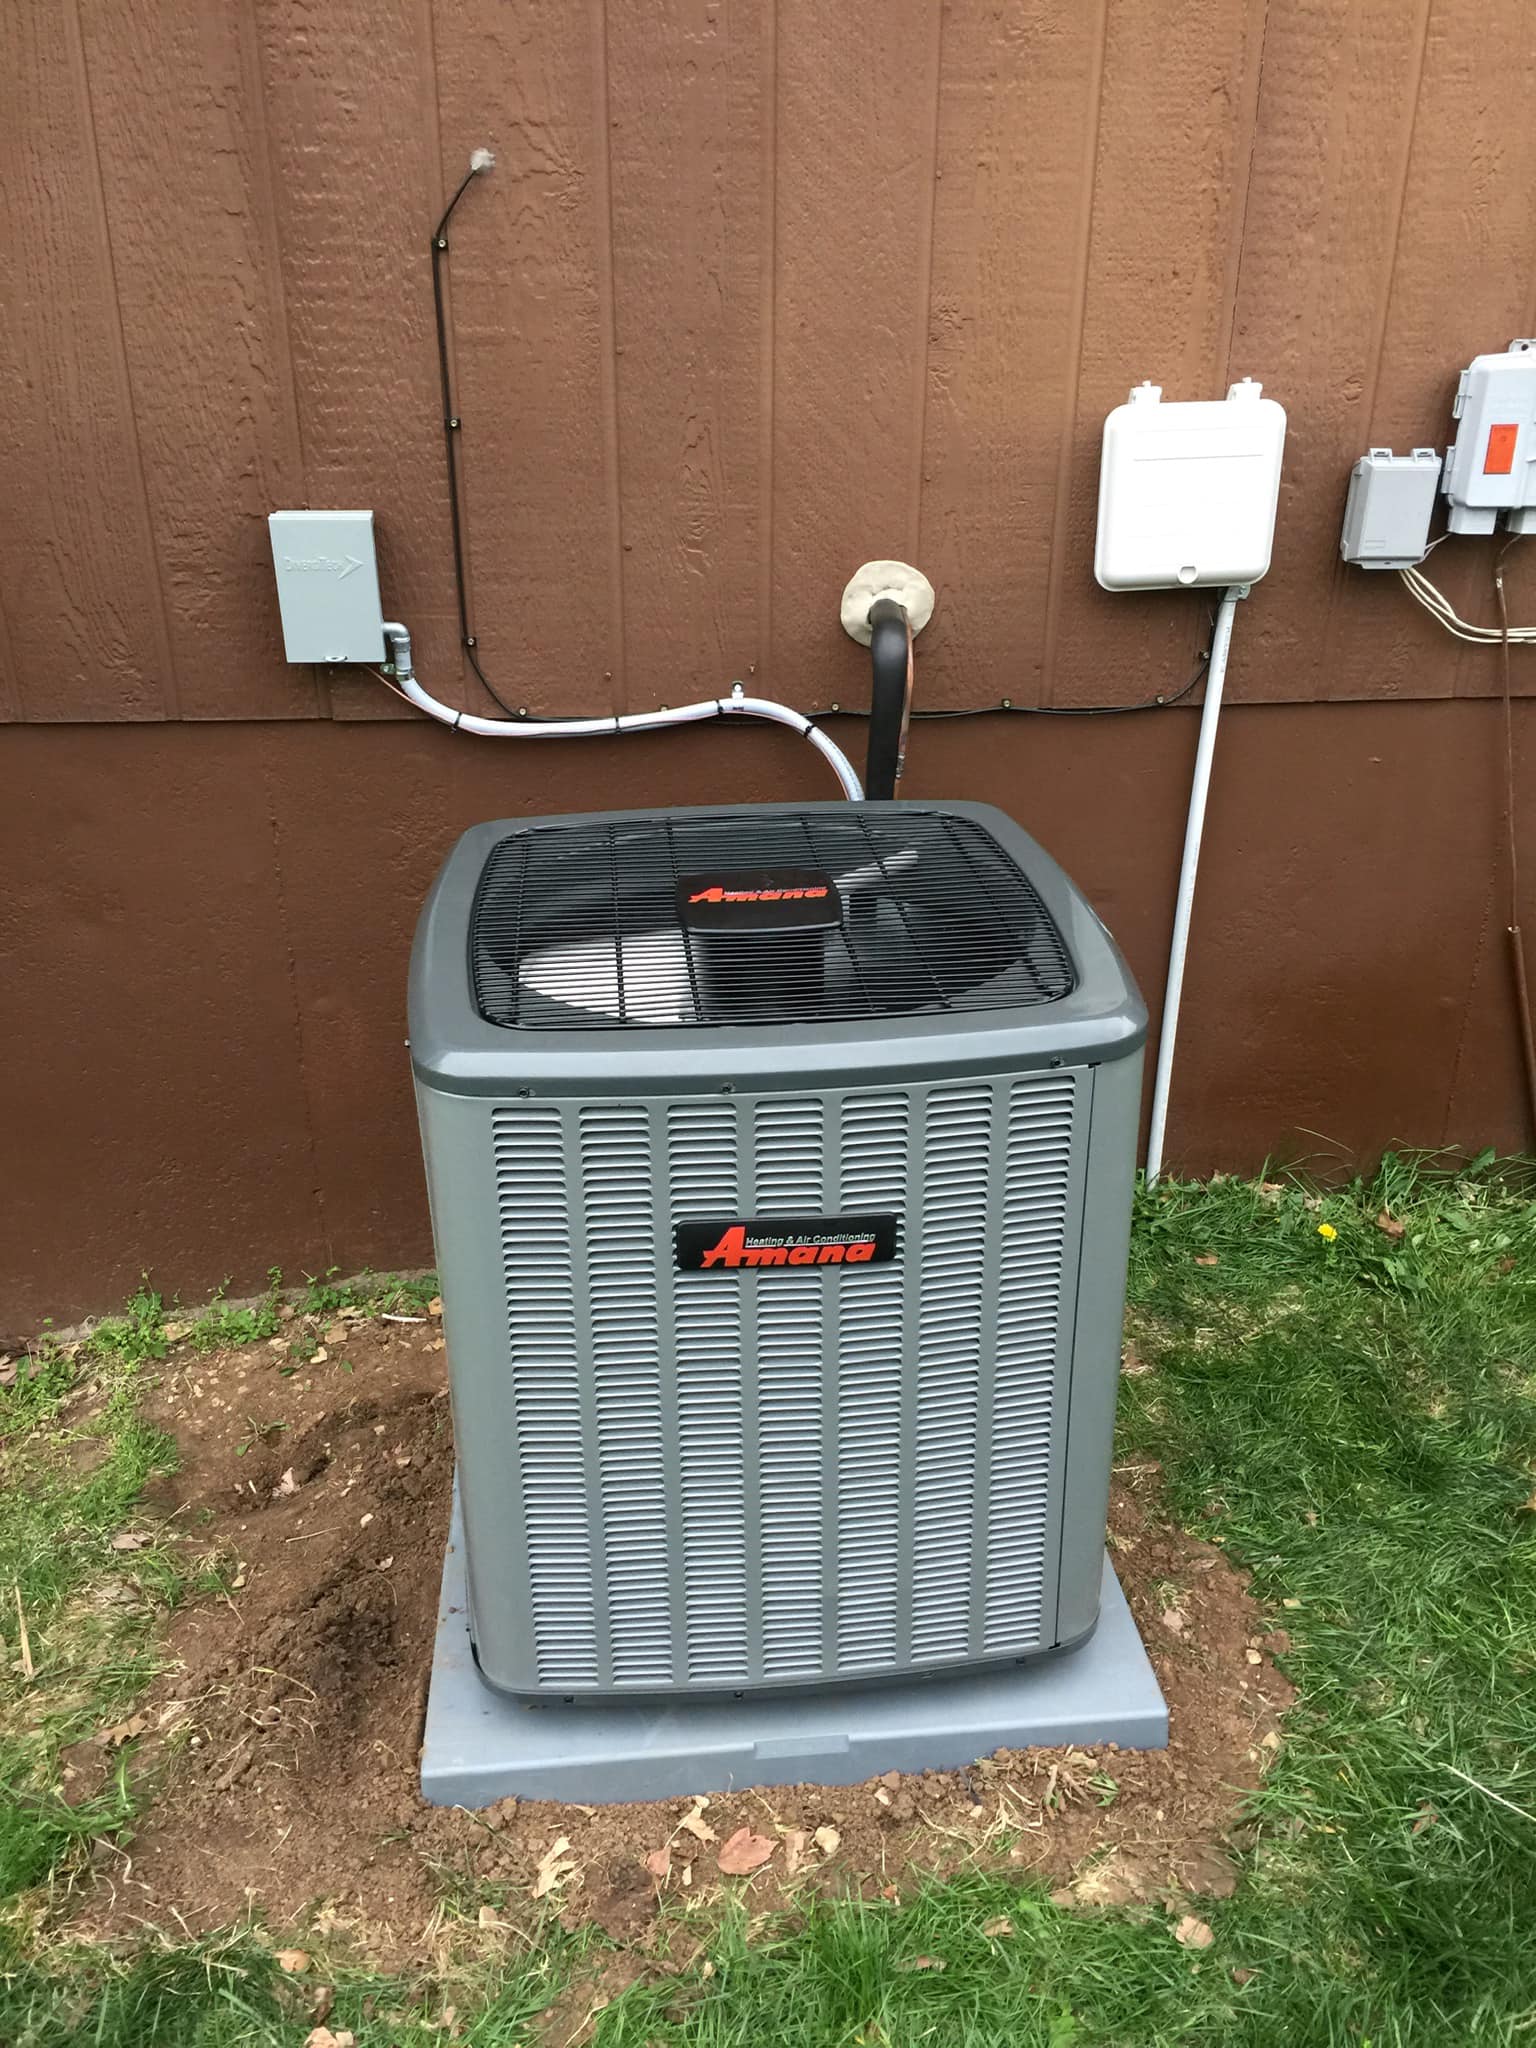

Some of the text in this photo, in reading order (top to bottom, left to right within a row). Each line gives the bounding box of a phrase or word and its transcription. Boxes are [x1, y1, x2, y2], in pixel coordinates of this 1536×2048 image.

[688, 887, 828, 903] Amana
[700, 1225, 876, 1268] Amana
[745, 1232, 876, 1247] Heating & Air Conditioning
